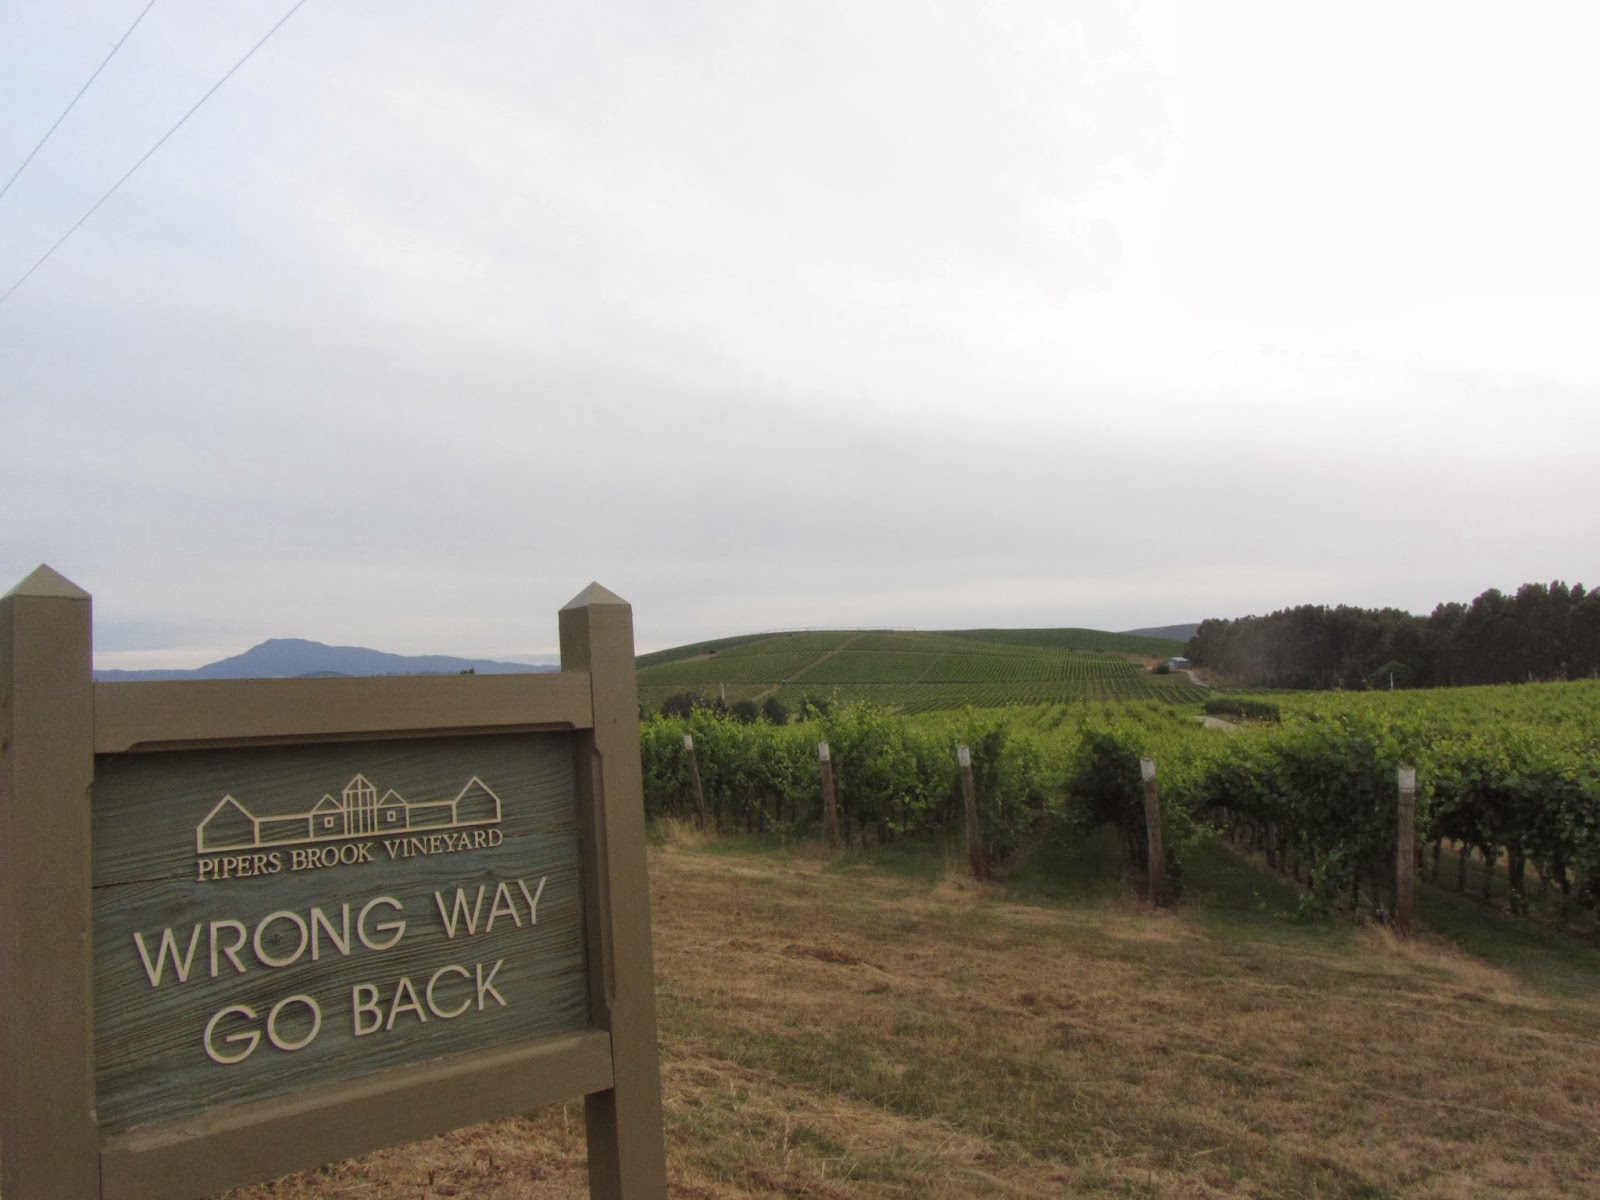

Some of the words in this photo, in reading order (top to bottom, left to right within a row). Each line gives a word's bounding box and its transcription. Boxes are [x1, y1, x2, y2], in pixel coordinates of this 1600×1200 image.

[197, 852, 281, 881] PIPERS
[291, 842, 374, 871] BROOK
[384, 828, 503, 859] VINEYARD
[133, 896, 407, 987] WRONG
[435, 876, 547, 939] WAY
[204, 994, 322, 1064] GO
[352, 959, 507, 1036] BACK
